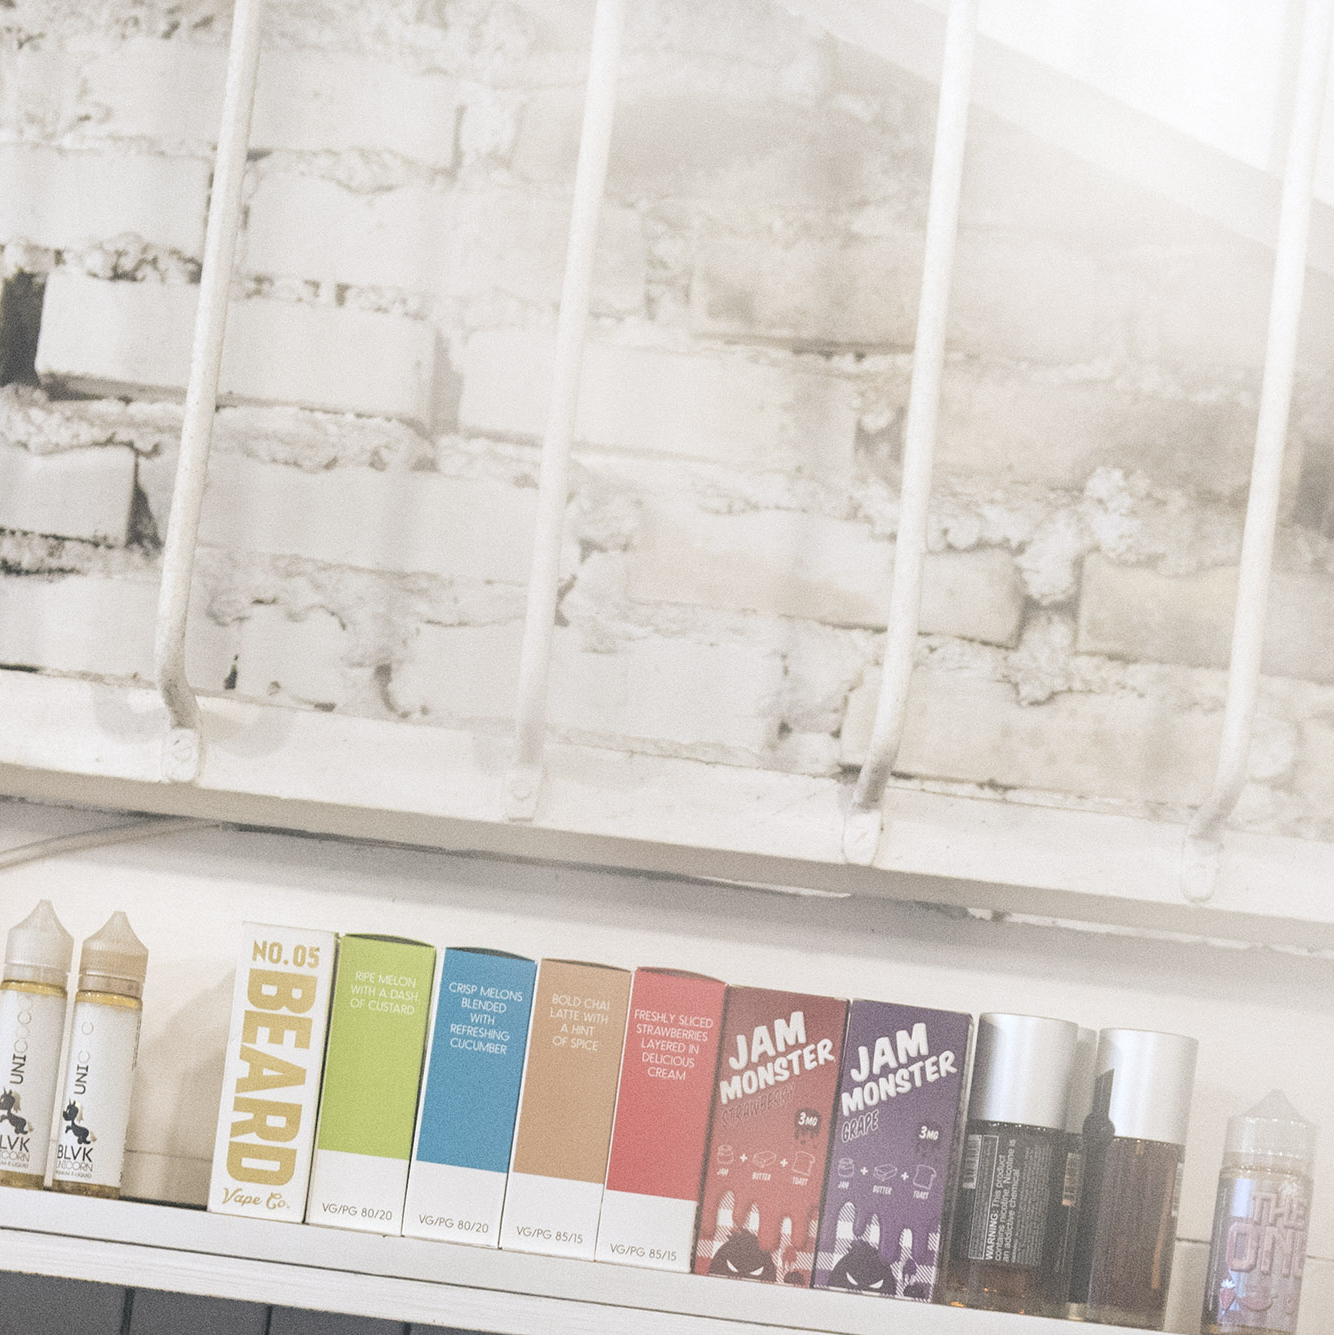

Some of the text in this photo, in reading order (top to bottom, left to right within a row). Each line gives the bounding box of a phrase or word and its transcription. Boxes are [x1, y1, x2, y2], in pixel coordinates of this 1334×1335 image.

[251, 939, 321, 969] NO. 05
[354, 971, 417, 988] RIPE MELON
[350, 984, 419, 1001] WITH A DASH
[448, 981, 524, 1002] CRISP MELONS
[349, 998, 416, 1015] OF CUSTARD
[460, 997, 507, 1014] BLENDED
[551, 993, 611, 1011] BOLD CHAI
[469, 1012, 495, 1025] WITH
[549, 1007, 609, 1025] LATTE WITH
[633, 1008, 714, 1030] FRESHLY SLICED
[449, 1023, 511, 1042] REFRESHING
[560, 1024, 596, 1037] A HINT
[635, 1023, 709, 1043] STRAWBERRIES
[449, 1037, 508, 1055] CUCUMBER
[552, 1035, 599, 1052] OF SPICE
[640, 1038, 700, 1055] LAYERED IN
[728, 1011, 807, 1071] JAM
[641, 1052, 696, 1068] DELICIOUS
[850, 1022, 929, 1083] JAM
[226, 967, 318, 1187] BEARD
[647, 1066, 687, 1081] CREAM
[719, 1038, 837, 1105] MONSTER
[841, 1050, 958, 1117] MONSTER
[841, 1108, 880, 1143] GRAPE
[1008, 1138, 1017, 1147] is
[57, 1144, 94, 1163] BLVK
[1003, 1148, 1015, 1184] Nicotine
[221, 1187, 291, 1211] Vape Co.
[872, 1184, 893, 1196] BUTTER
[322, 1202, 393, 1222] VG/PG 80/20
[985, 1154, 1006, 1260] WARNING: This product
[1251, 1191, 1307, 1232] THE
[418, 1213, 490, 1234] VG/PG 80/20
[1004, 1209, 1016, 1248] addictive
[516, 1225, 584, 1245] VG/PG 85/15
[994, 1224, 1005, 1261] contains
[609, 1243, 678, 1262] VG/PG 85/15
[1002, 1250, 1010, 1262] an
